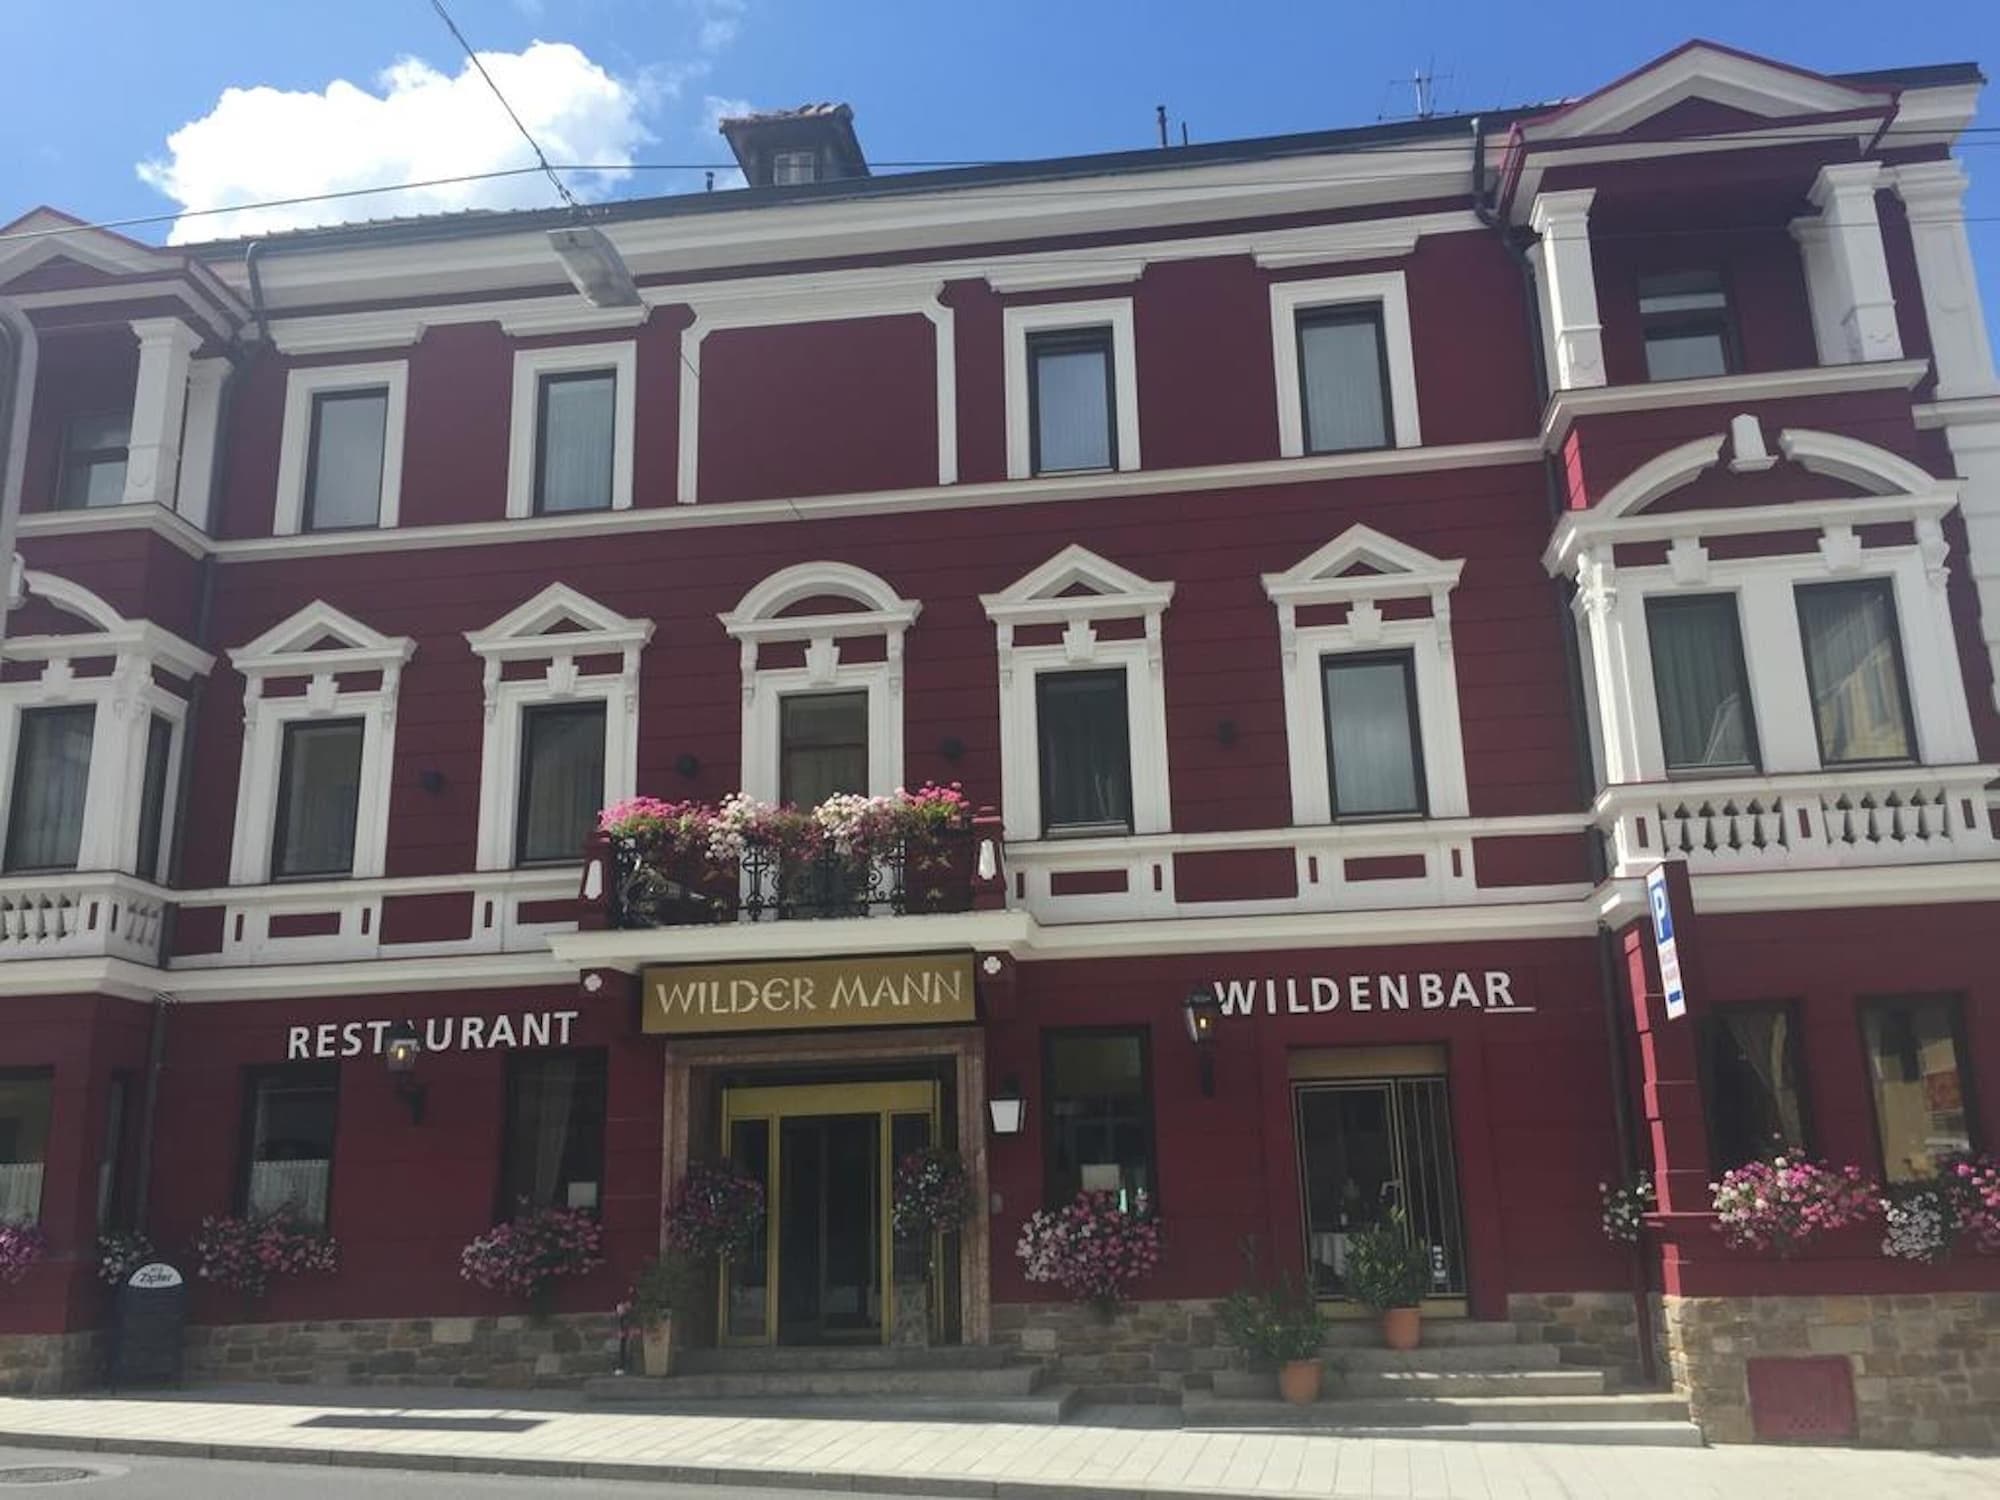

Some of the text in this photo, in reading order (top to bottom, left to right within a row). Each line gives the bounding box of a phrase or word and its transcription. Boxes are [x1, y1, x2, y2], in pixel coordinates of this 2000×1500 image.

[1653, 887, 1667, 939] P
[656, 970, 962, 1015] WILDER MANN
[1214, 971, 1515, 1015] WILDENBAR
[287, 1011, 579, 1060] RESTURANT
